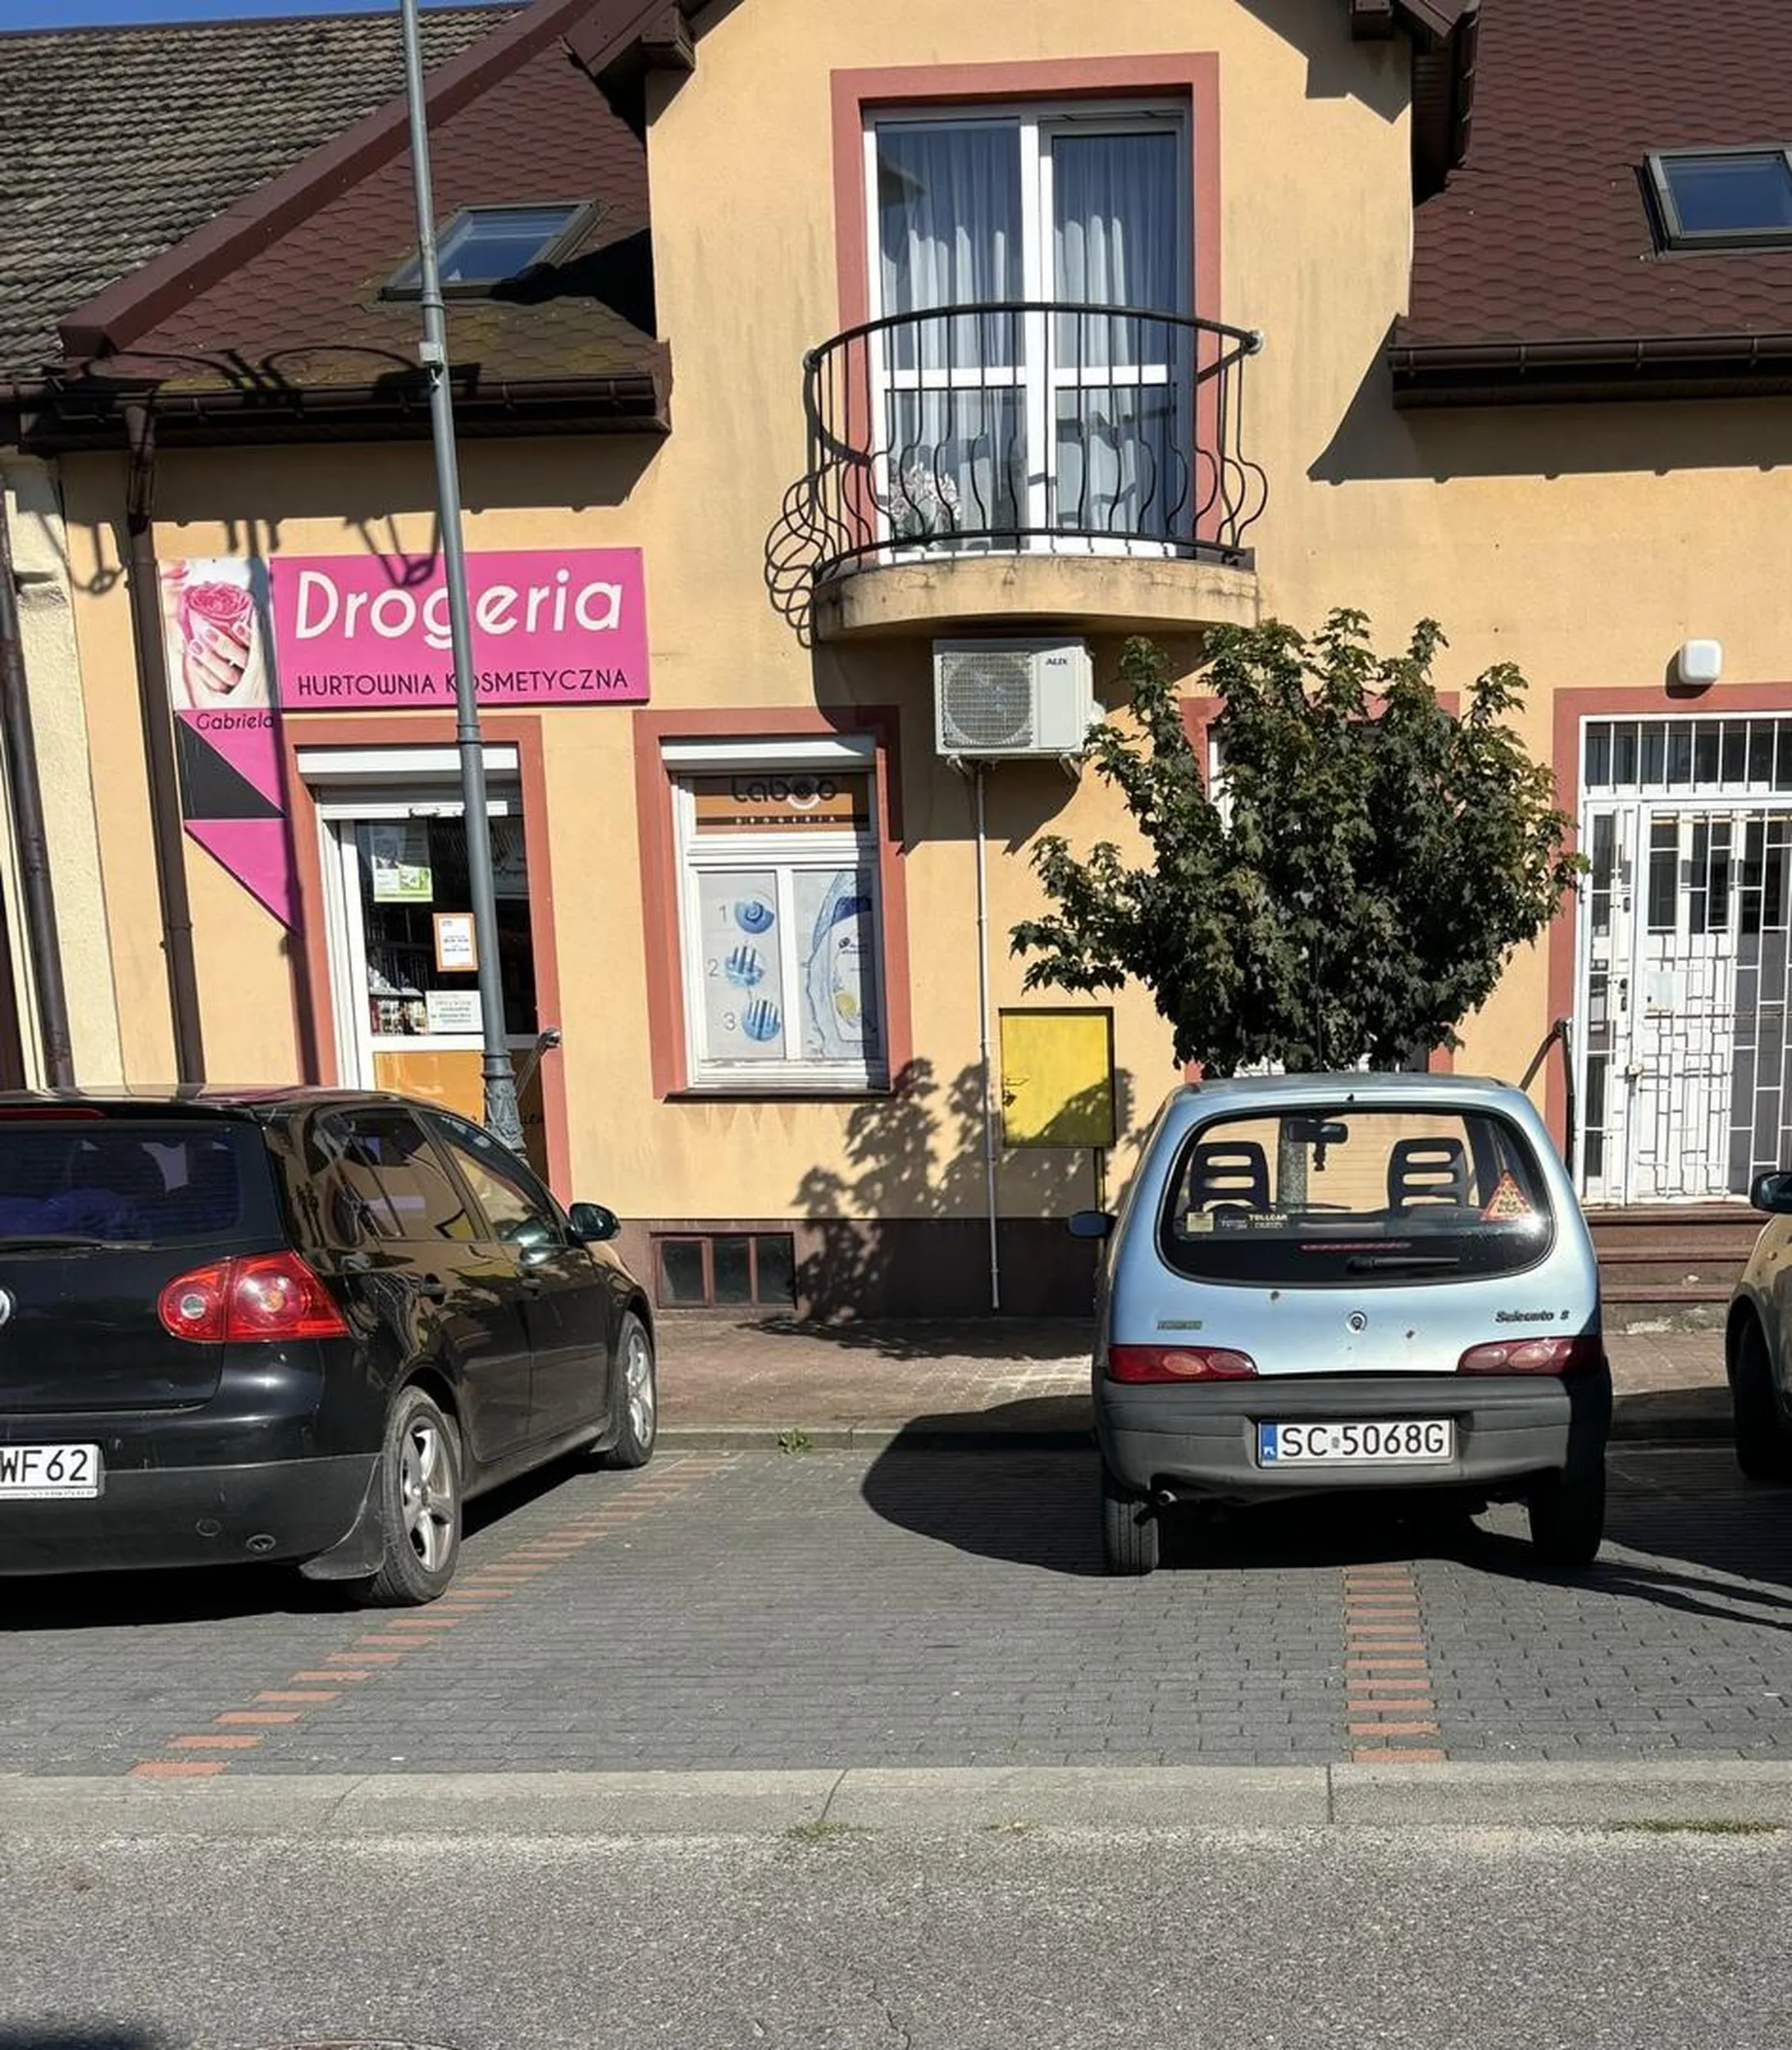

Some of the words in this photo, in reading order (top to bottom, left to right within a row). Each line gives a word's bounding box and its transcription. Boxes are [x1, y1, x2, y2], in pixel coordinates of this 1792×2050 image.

[296, 568, 622, 649] Drogeria
[298, 673, 436, 696] HURTOWNIA
[445, 668, 628, 693] KSMETYCZNA
[196, 712, 275, 730] Gabriela
[718, 904, 727, 922] 1
[707, 957, 720, 977] 2
[723, 1011, 736, 1032] 3
[1281, 1427, 1329, 1457] SC
[1342, 1423, 1444, 1456] 5068G
[0, 1449, 89, 1483] WF62
